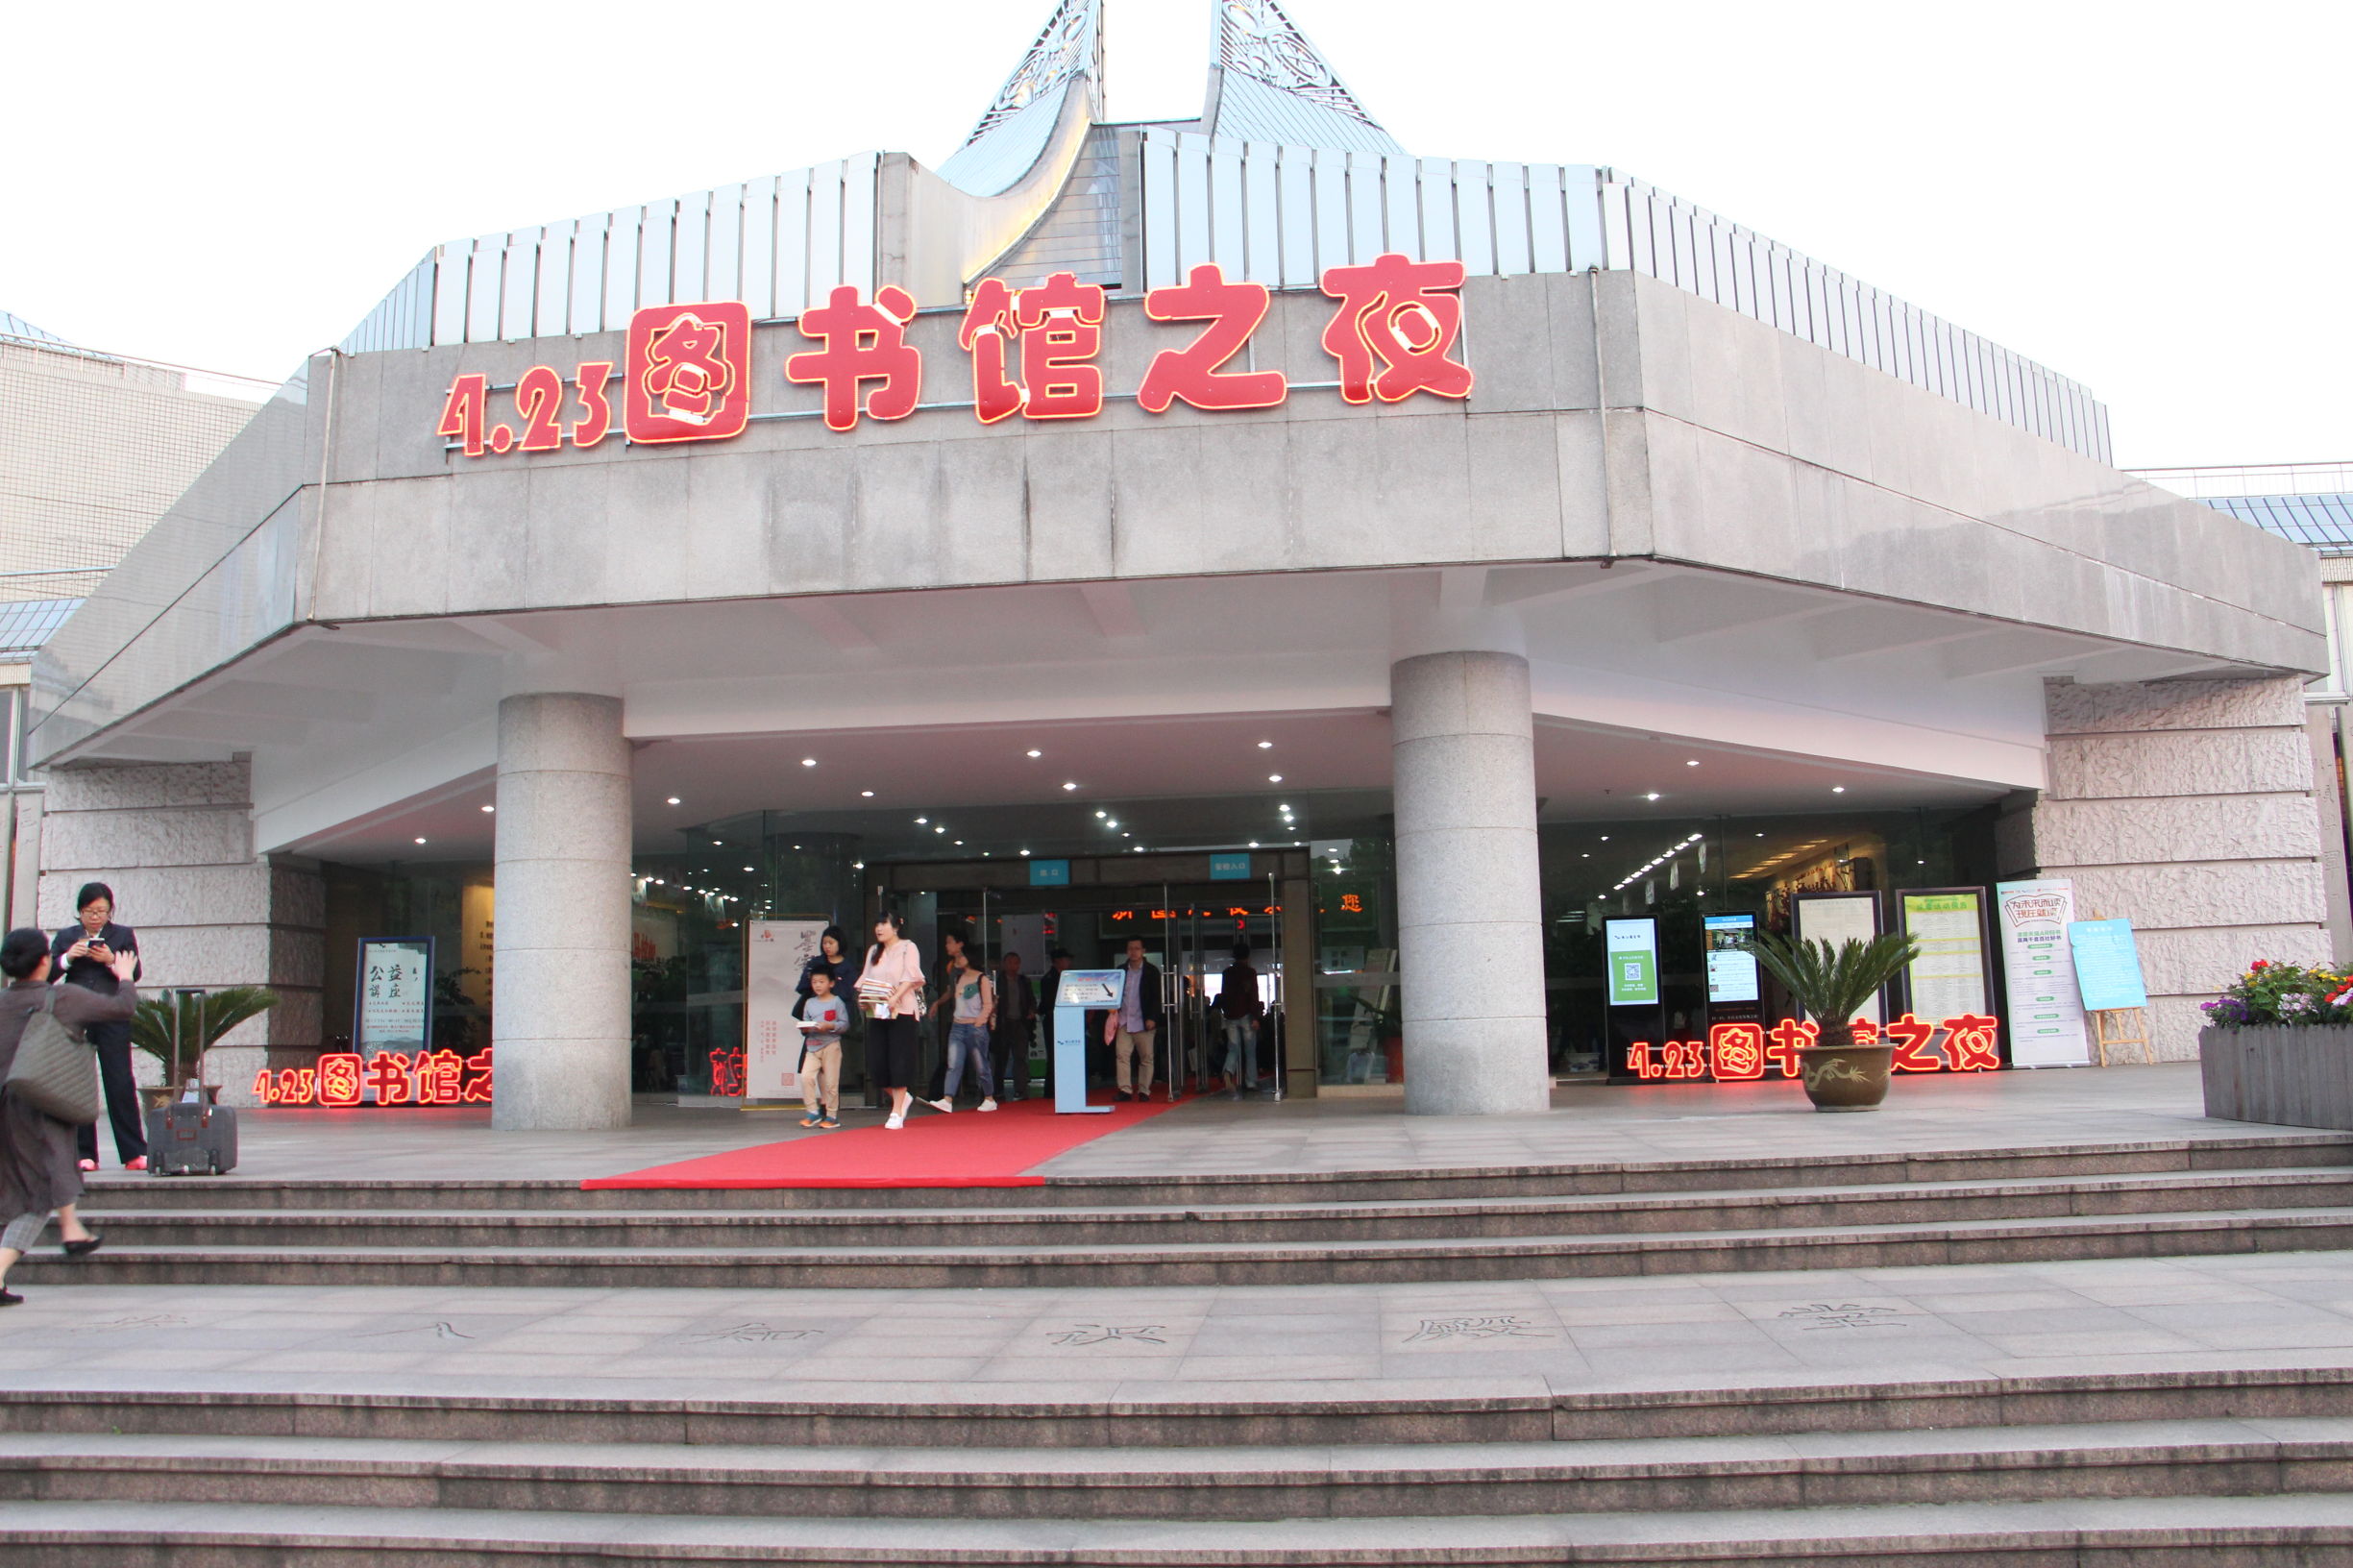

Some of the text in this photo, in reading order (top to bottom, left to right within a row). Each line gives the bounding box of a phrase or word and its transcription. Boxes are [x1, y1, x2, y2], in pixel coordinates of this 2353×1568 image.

[437, 253, 1475, 458] 4.23图书馆之夜
[370, 964, 403, 981] 公益
